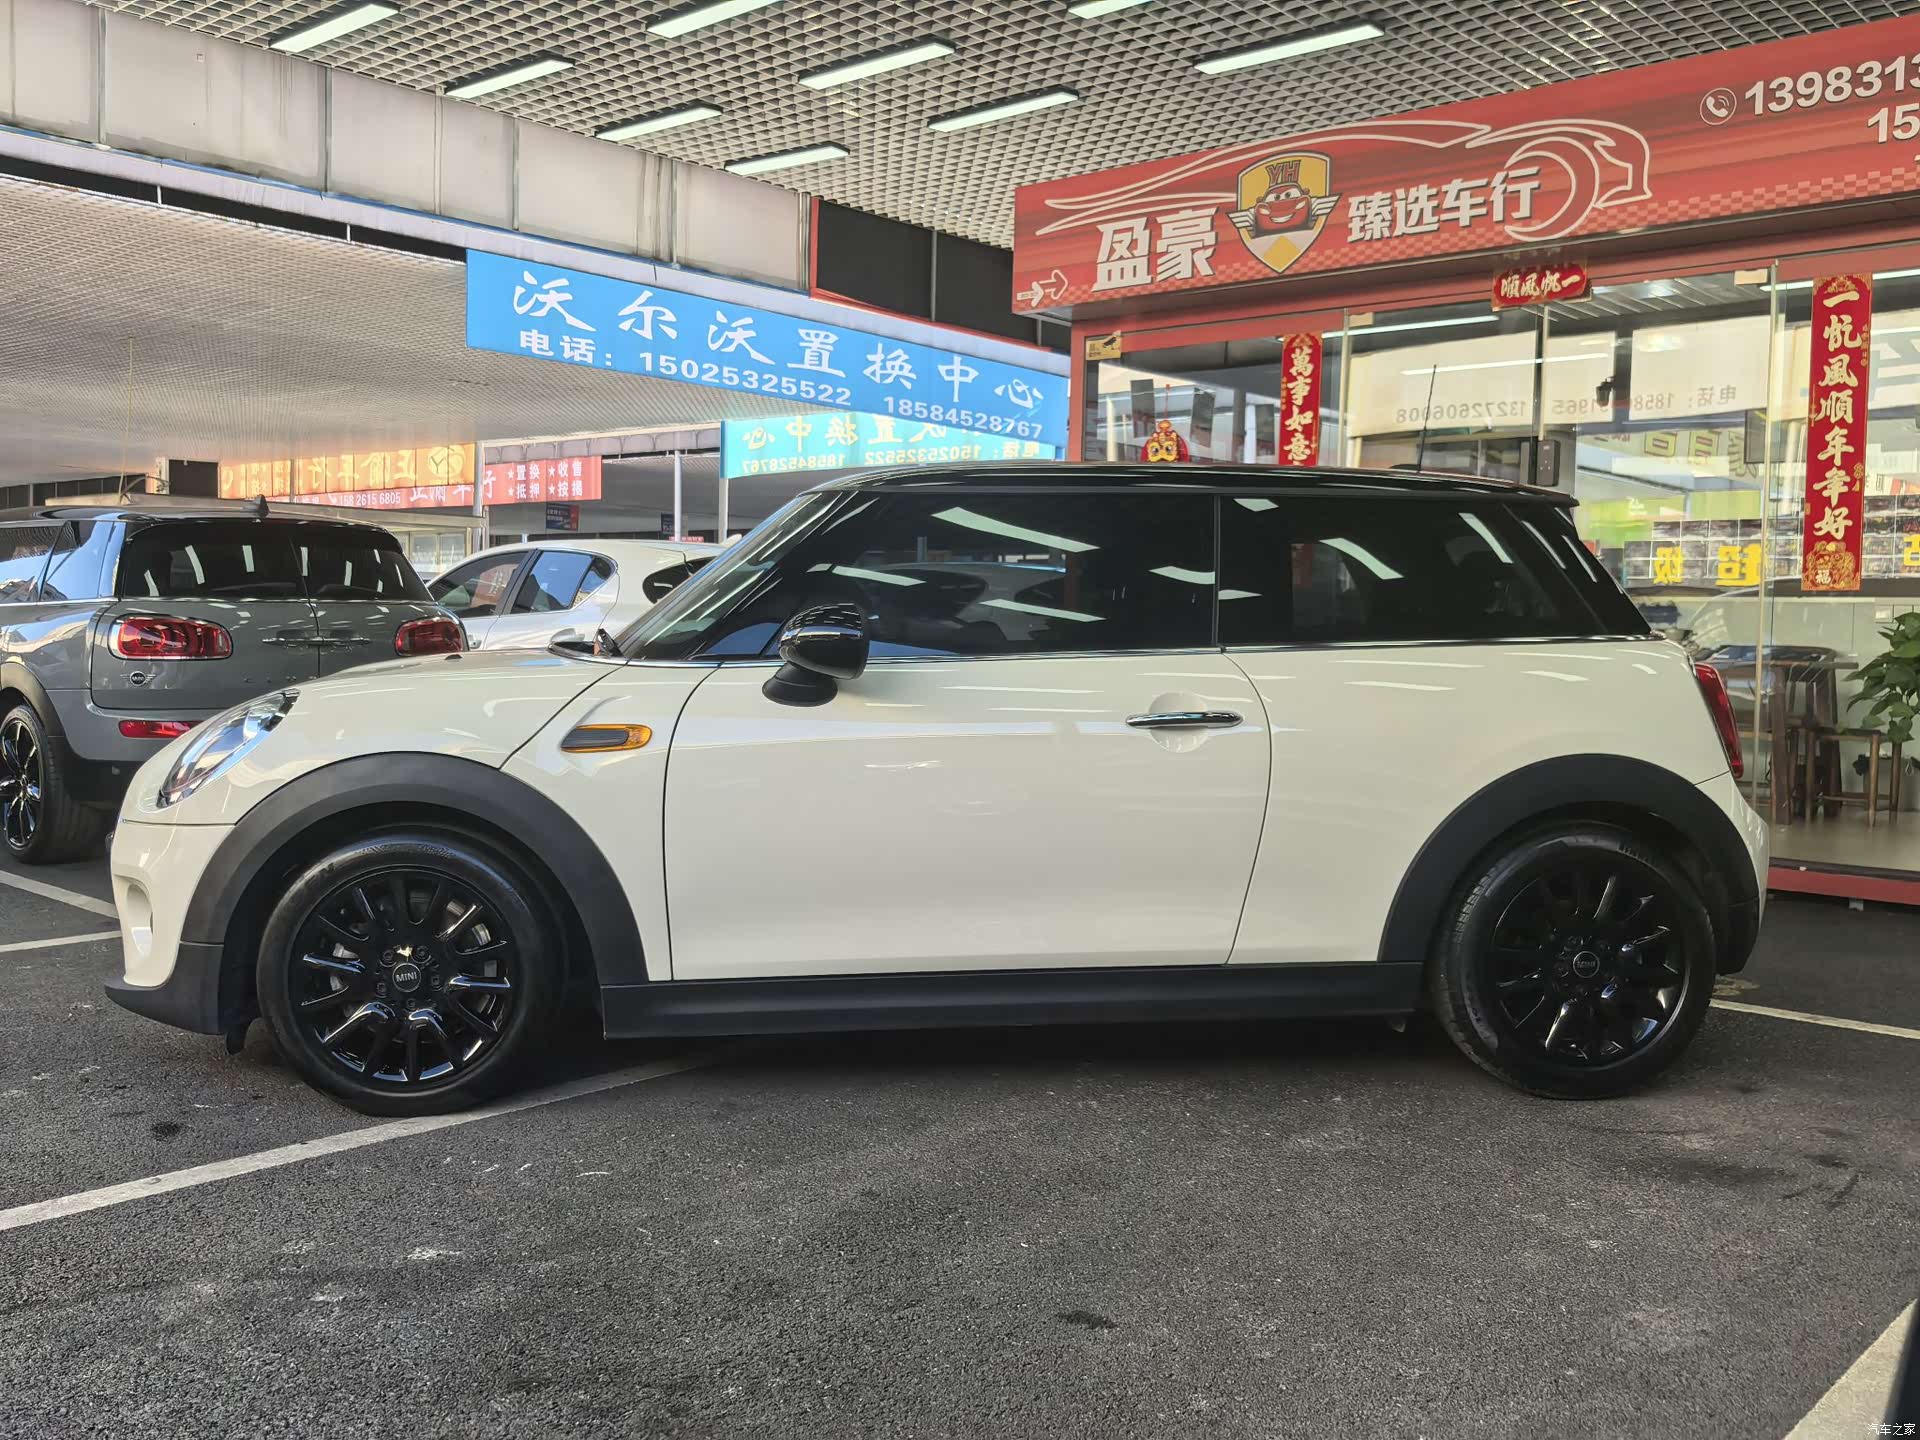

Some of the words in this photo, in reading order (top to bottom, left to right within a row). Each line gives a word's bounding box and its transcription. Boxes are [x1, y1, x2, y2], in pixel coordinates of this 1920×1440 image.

[1266, 160, 1301, 184] YH
[1347, 166, 1541, 242] 臻选车行
[1092, 206, 1219, 292] 盈豪
[513, 270, 1044, 409] 沃尔沃置换中心
[639, 352, 851, 406] 15025325522
[883, 396, 1043, 439] 18584528767
[516, 462, 541, 481] 置换
[557, 459, 583, 479] 收售
[380, 491, 401, 505] 6805
[516, 482, 541, 500] 抵押
[557, 479, 583, 498] 按揭
[395, 971, 418, 982] MINI
